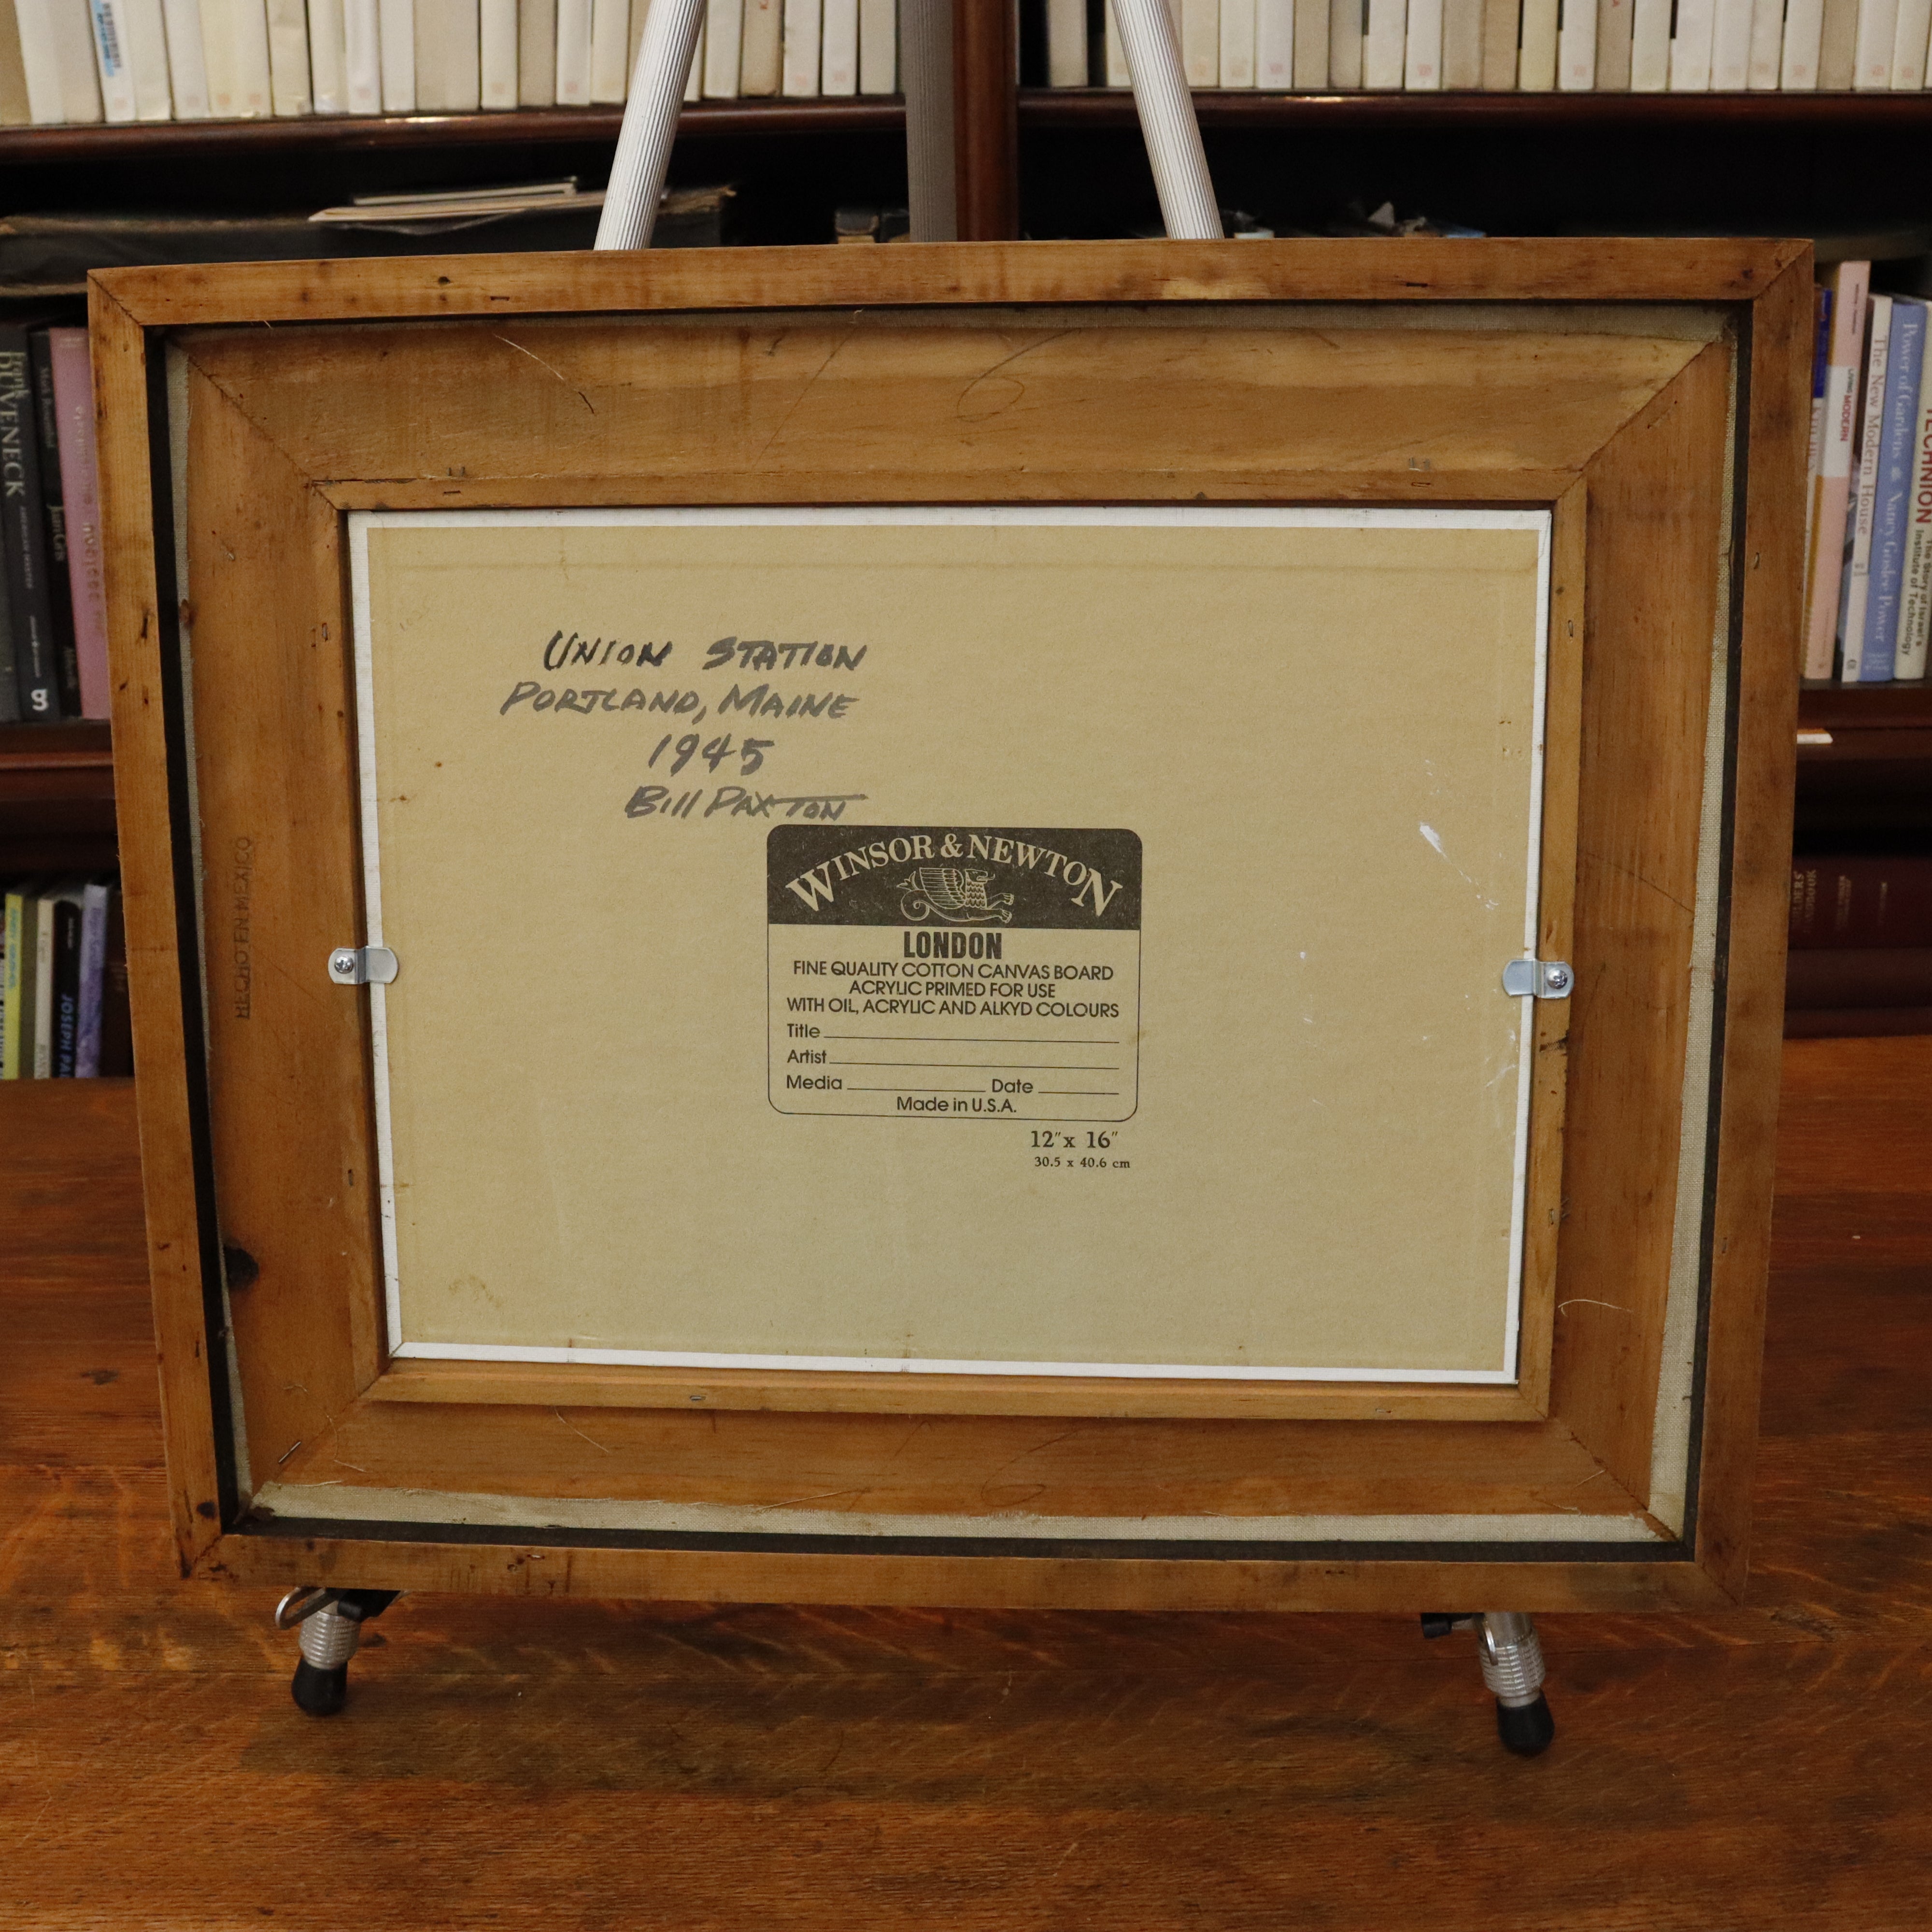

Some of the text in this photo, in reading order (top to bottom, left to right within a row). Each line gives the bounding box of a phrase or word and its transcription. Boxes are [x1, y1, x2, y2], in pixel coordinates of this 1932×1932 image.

[1899, 324, 1918, 372] Power
[1898, 375, 1913, 392] of
[0, 352, 25, 497] DUVENECK
[1841, 395, 1852, 441] MODERN
[1858, 336, 1887, 534] The New Modern House
[1892, 395, 1912, 458] Gardens
[1880, 493, 1903, 536] Nancy
[1902, 529, 1924, 655] Institute of Technology
[1920, 594, 1928, 605] of
[1875, 596, 1892, 640] Power
[543, 630, 867, 671] UNION STATION
[499, 681, 860, 725] PORTLAND, MAINE
[648, 733, 775, 777] 1945
[785, 833, 1124, 918] WINSOR & NEWTON
[234, 836, 252, 1020] HECHO EN MEXICO
[904, 931, 1002, 960] LONDON
[794, 960, 1114, 980] FINE QUALITY COTTON CANVAS BOARD
[849, 980, 1055, 998] ACRYLIC PRIMED FOR USE
[60, 994, 73, 1051] JOSEPH
[786, 997, 1119, 1018] WITH OIL, ACRYLIC AND ALKYD COLOURS
[787, 1023, 821, 1038] Title
[787, 1049, 827, 1064] Artist
[786, 1075, 1034, 1094] Media Date
[897, 1096, 1017, 1113] Made in U.S.A.
[1035, 1156, 1061, 1167] 30.5
[1080, 1157, 1107, 1168] 40.6
